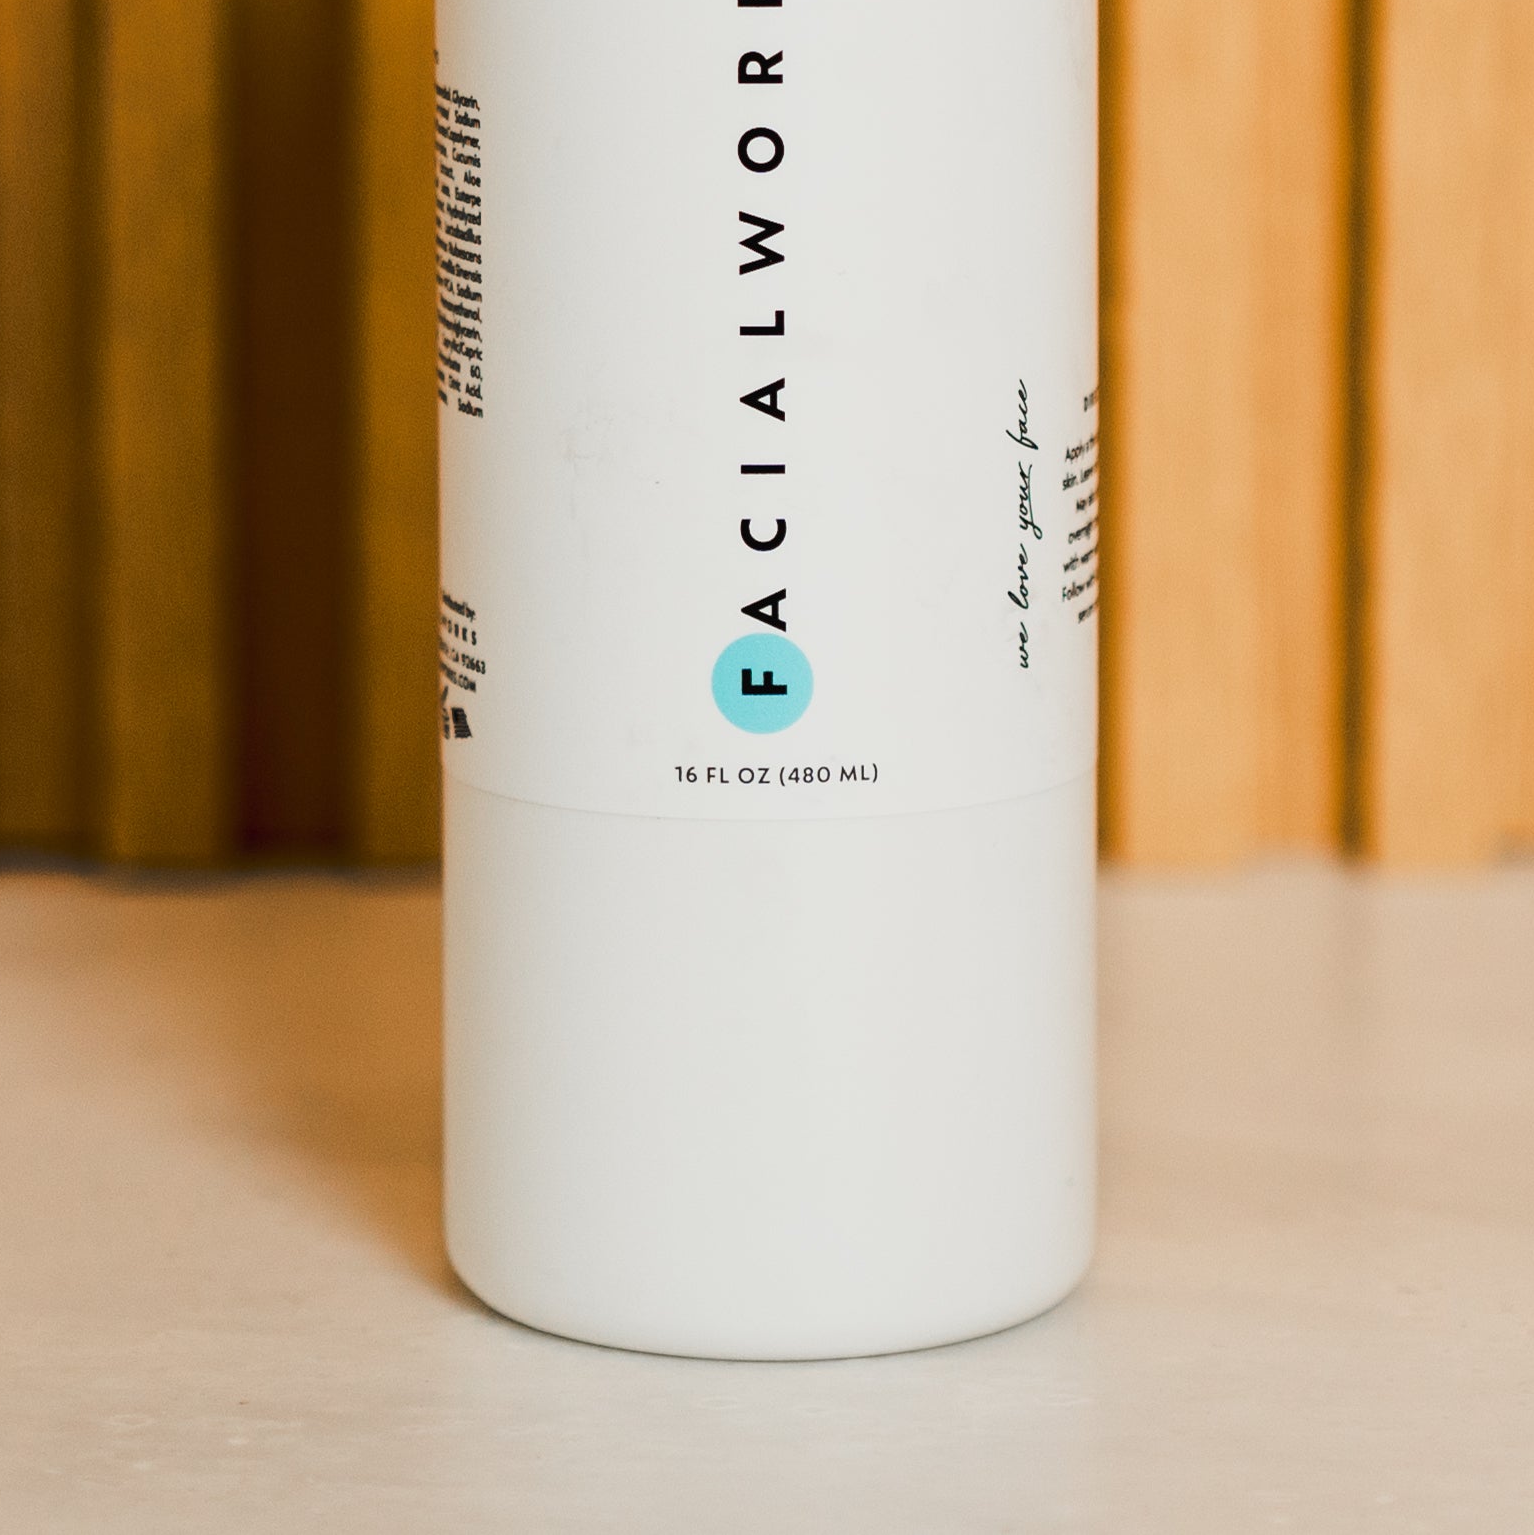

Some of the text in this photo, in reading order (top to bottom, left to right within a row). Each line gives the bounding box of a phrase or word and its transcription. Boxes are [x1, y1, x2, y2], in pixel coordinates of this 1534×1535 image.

[1005, 378, 1043, 669] we love your face
[674, 763, 879, 787] 16 FL OZ (480 ML)
